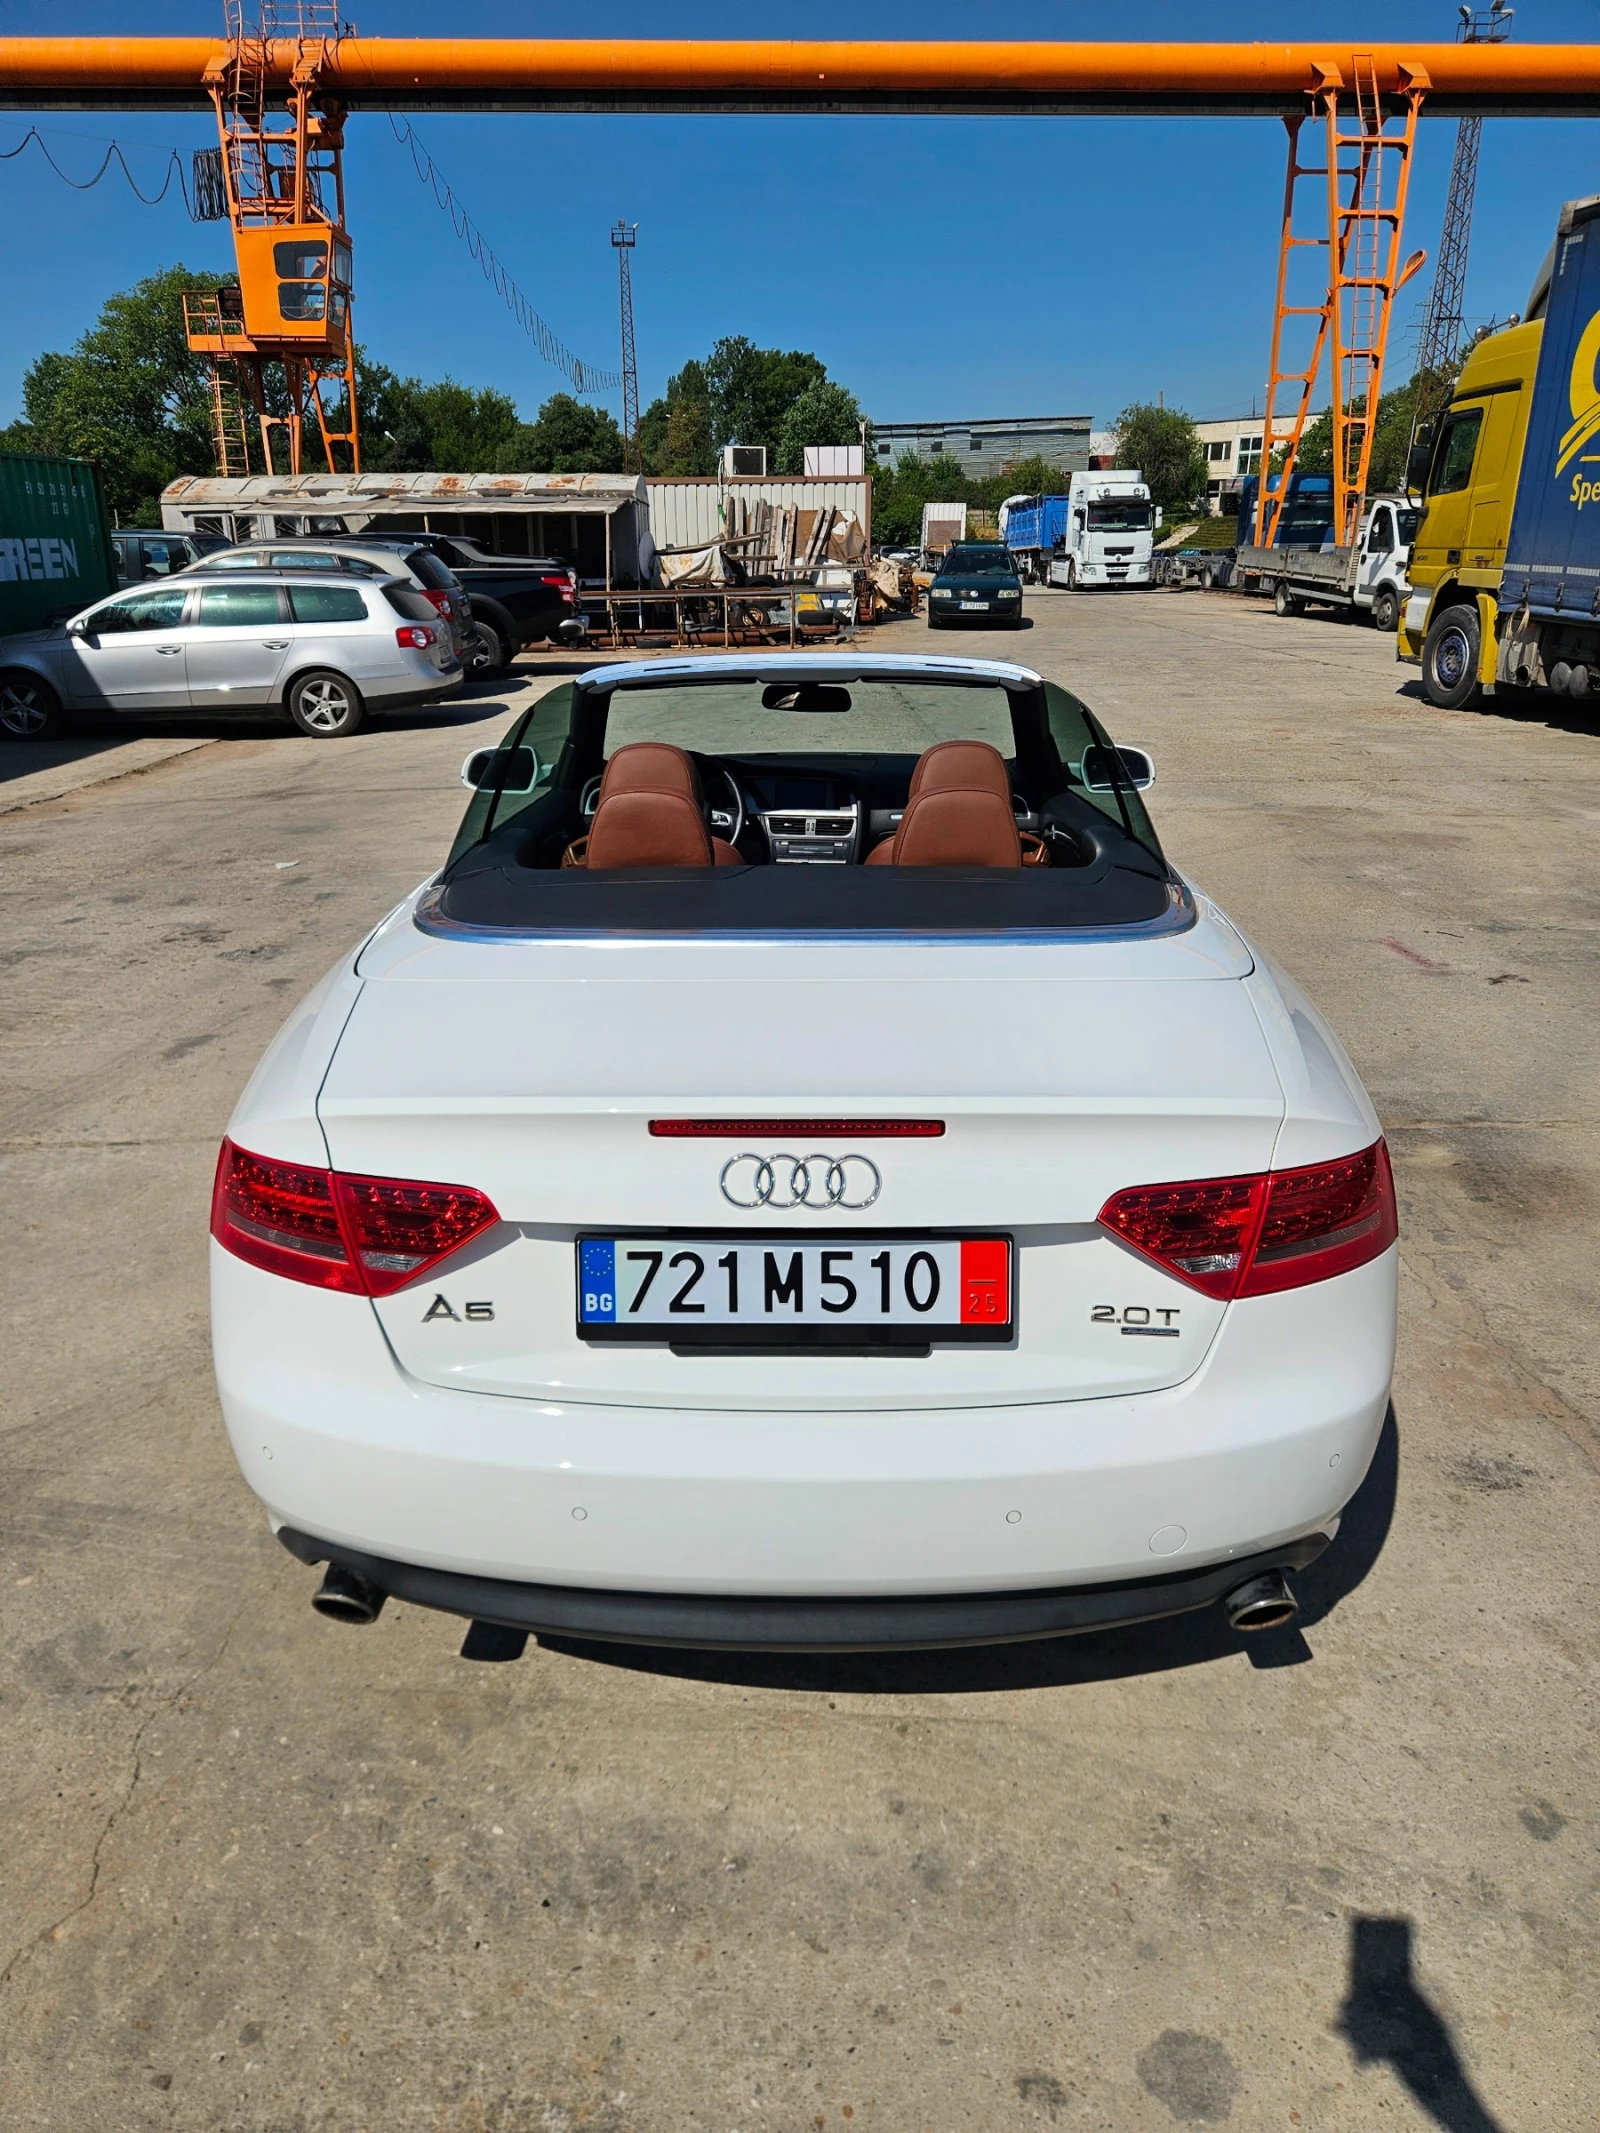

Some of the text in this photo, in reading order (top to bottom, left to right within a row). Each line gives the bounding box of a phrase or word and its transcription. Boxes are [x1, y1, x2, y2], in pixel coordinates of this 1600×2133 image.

[421, 1293, 496, 1323] A5
[585, 1293, 613, 1312] BG
[969, 1293, 998, 1314] 25
[1091, 1305, 1180, 1326] 2.0T
